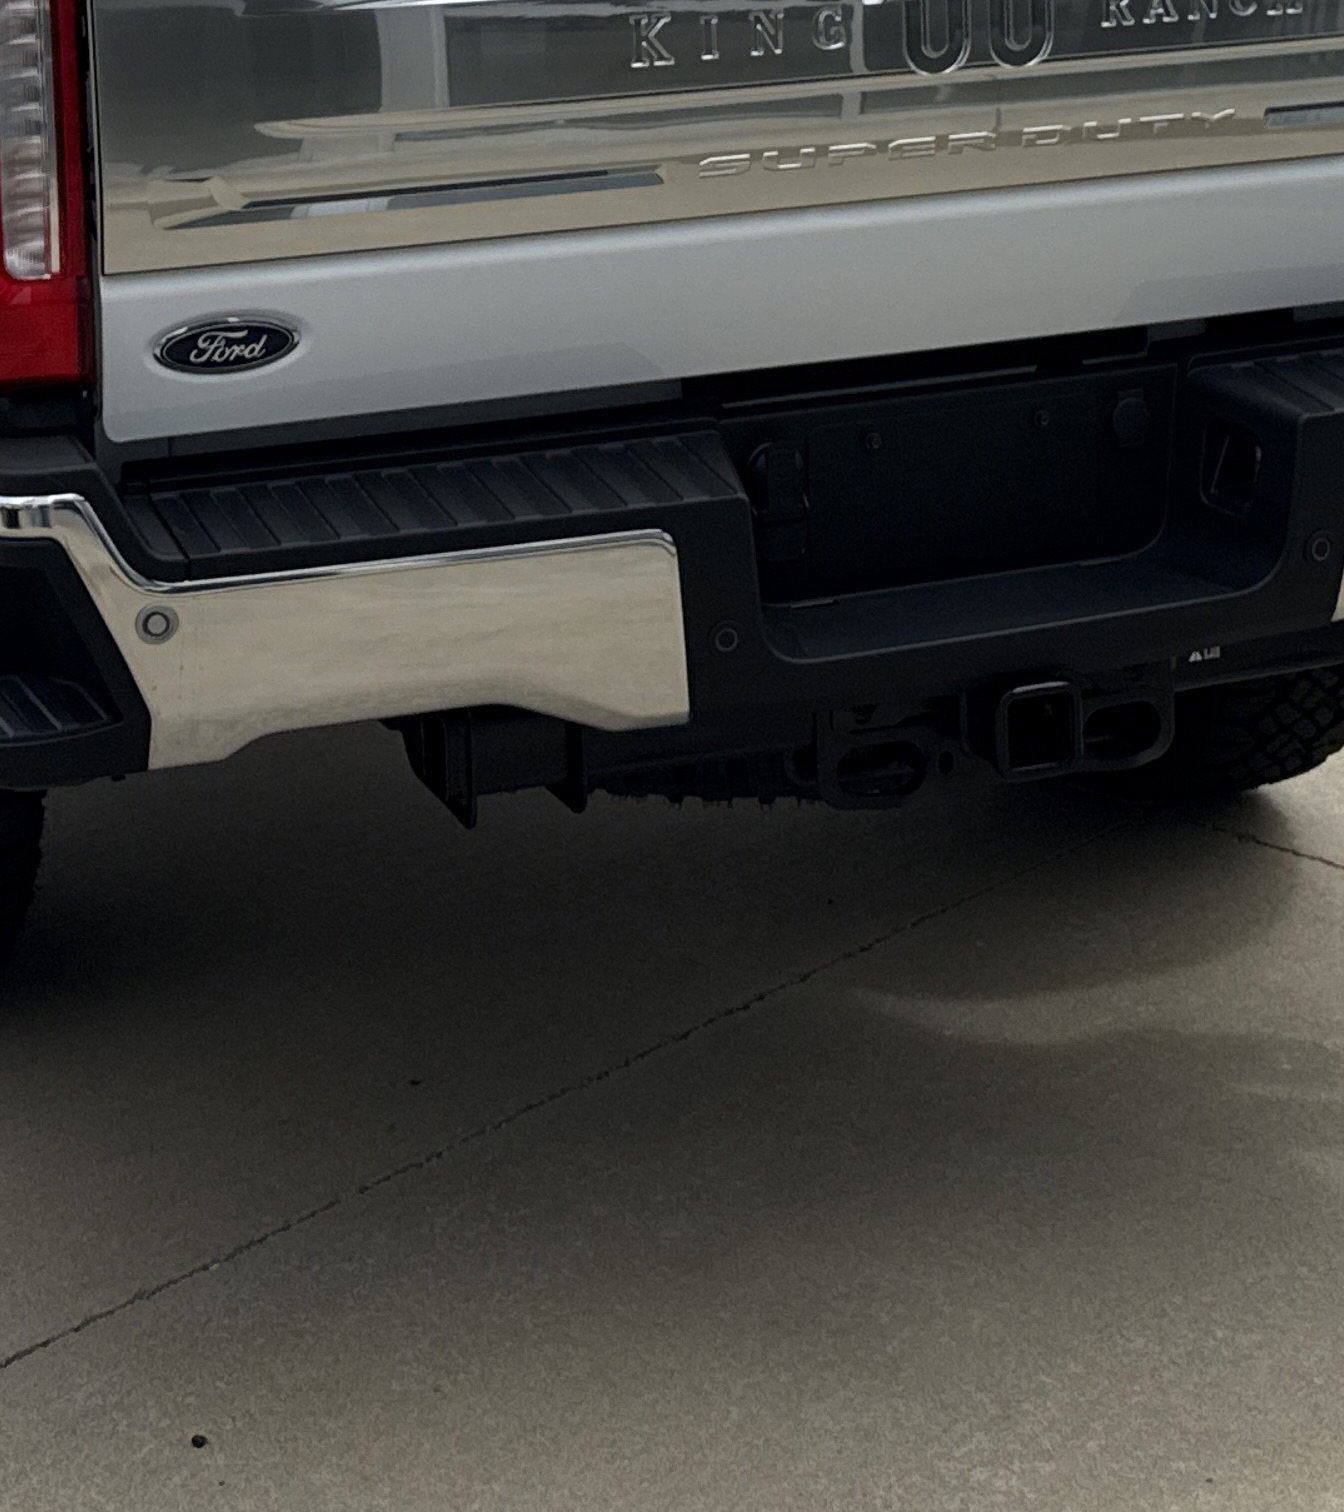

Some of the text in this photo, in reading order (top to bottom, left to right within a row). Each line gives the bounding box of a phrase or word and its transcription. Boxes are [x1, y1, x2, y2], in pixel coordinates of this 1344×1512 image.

[628, 3, 849, 68] KING
[698, 107, 1236, 180] SUPER DUTY
[189, 329, 267, 365] Ford
